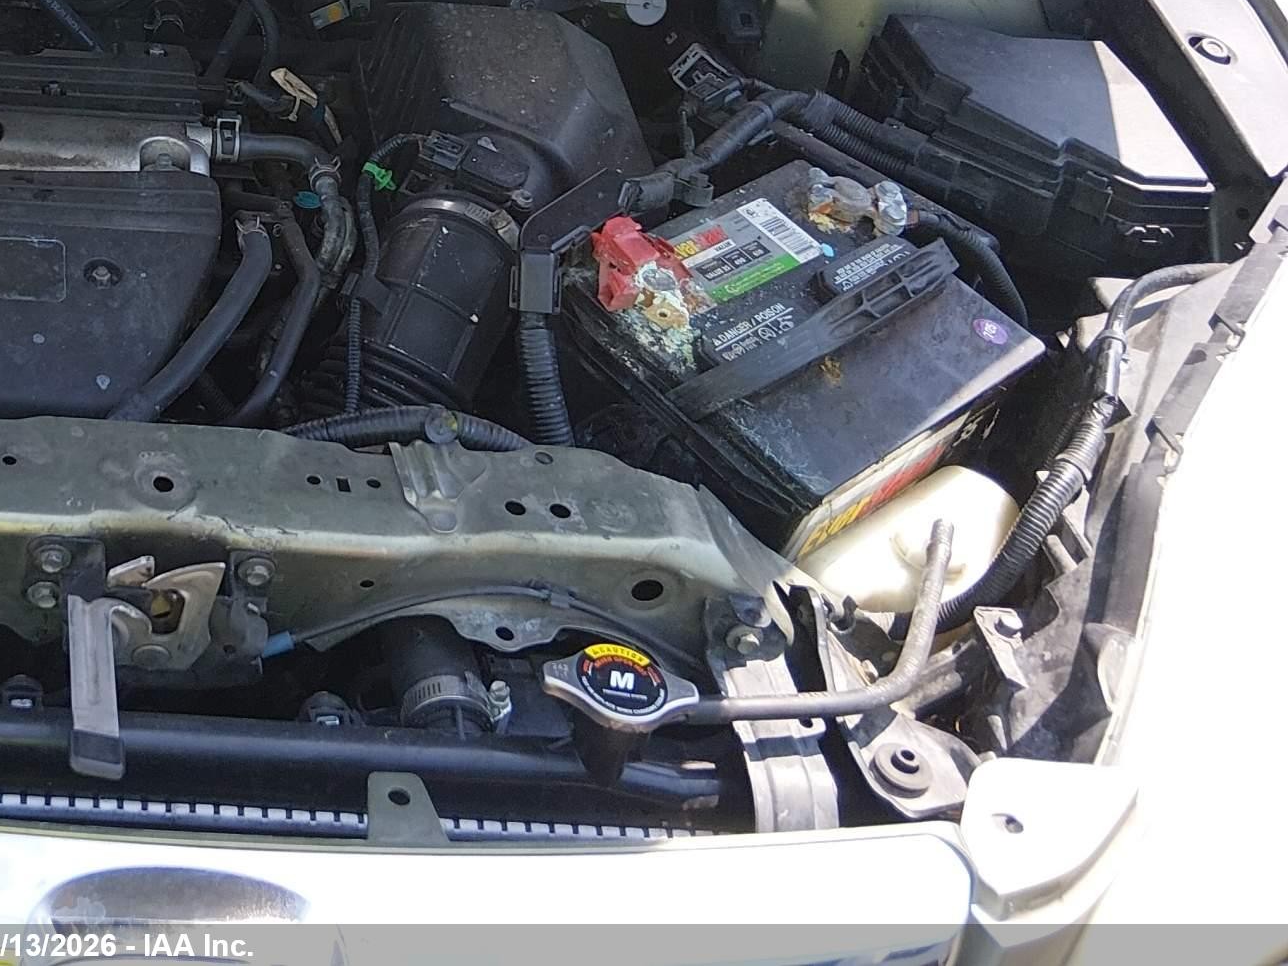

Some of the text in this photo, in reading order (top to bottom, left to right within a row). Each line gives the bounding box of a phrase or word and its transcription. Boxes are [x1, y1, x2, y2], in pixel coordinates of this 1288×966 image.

[717, 321, 753, 343] DANGER
[754, 302, 786, 323] POISON
[610, 671, 635, 690] M
